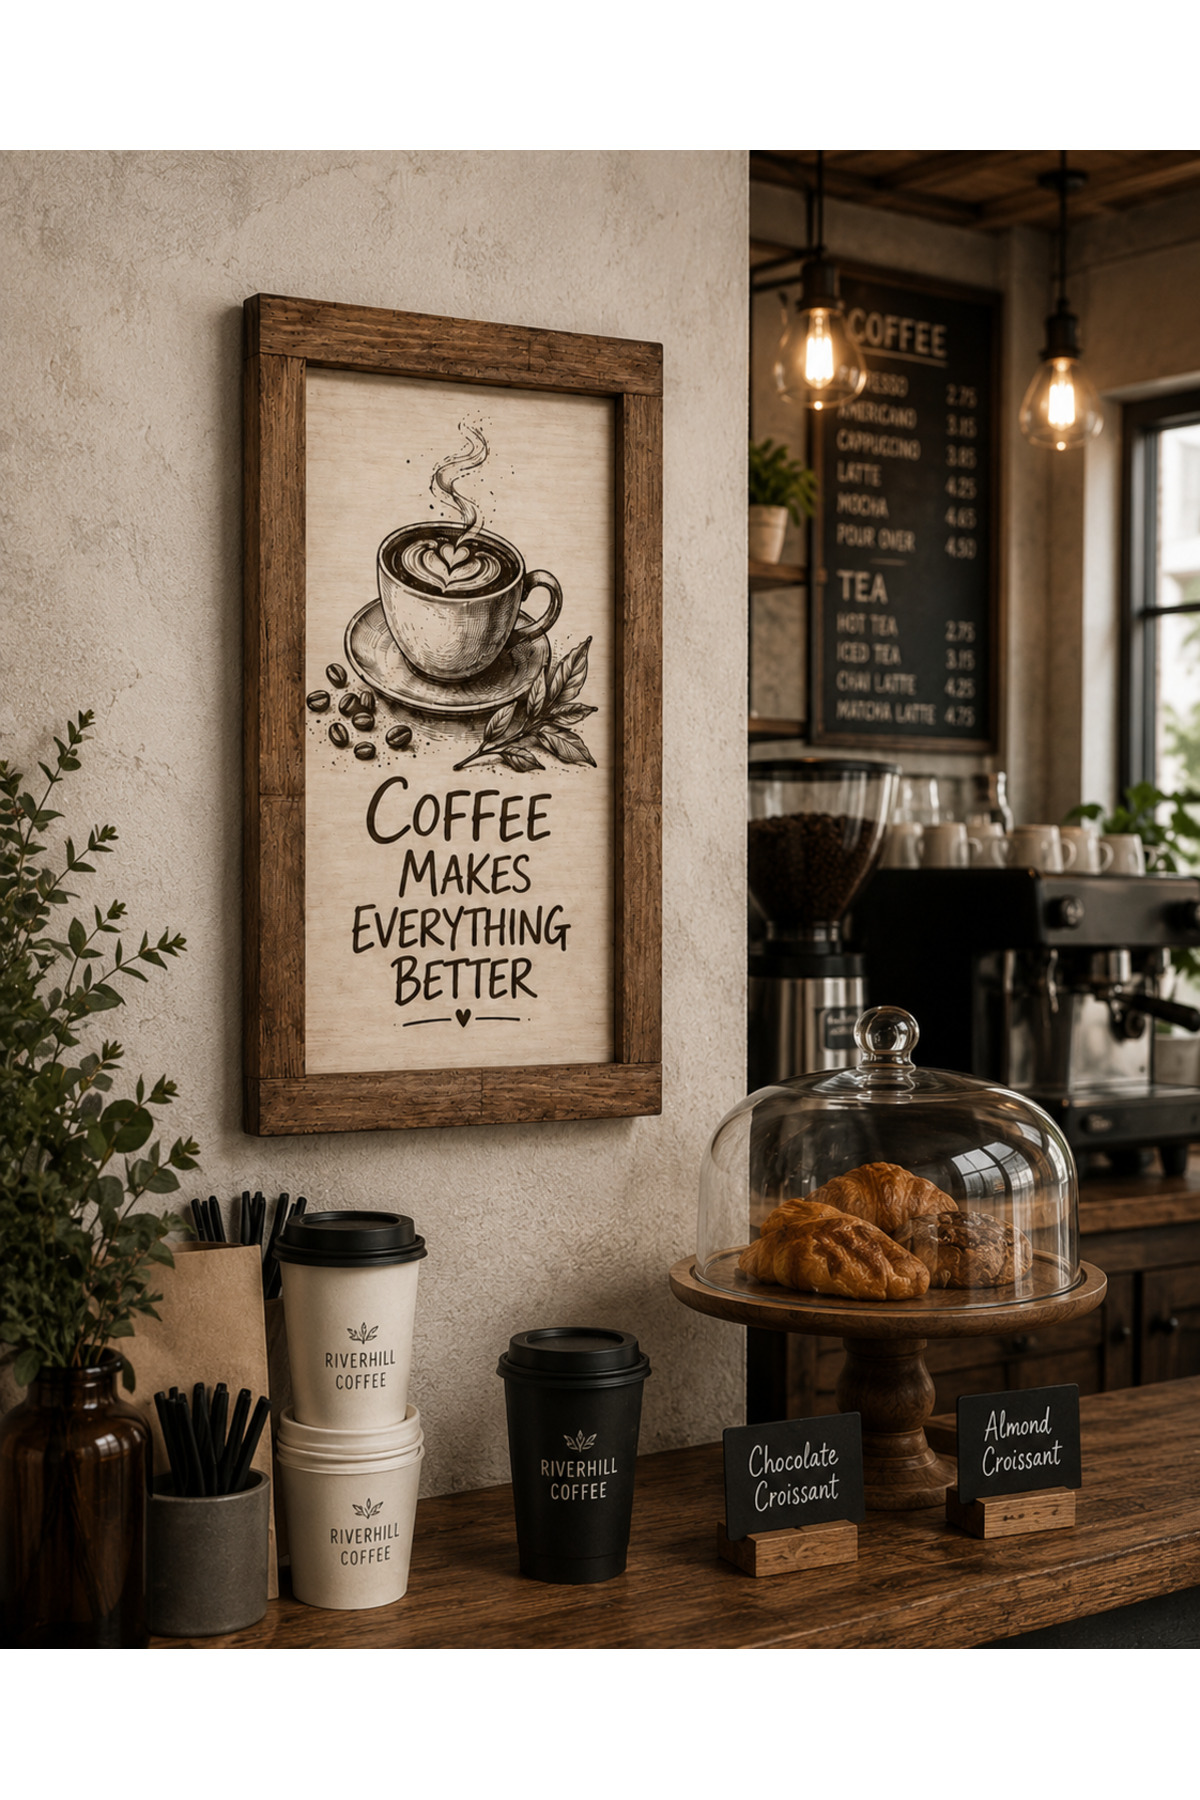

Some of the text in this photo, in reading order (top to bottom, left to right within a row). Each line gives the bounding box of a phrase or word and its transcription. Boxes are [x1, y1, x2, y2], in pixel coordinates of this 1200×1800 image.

[847, 307, 947, 358] COFFEE
[837, 400, 917, 430] AMERICANO
[836, 428, 921, 461] CAPPUCCINO
[836, 459, 977, 500] LATTE 4.25
[836, 491, 889, 519] MOCHA
[836, 522, 875, 549] POUR
[878, 527, 916, 554] OVER
[836, 569, 888, 604] TEA
[836, 611, 976, 643] HOT TEA 2.75
[836, 640, 870, 664] ICED
[873, 642, 902, 666] TEA
[836, 669, 976, 699] CHAI LATTE 4.25
[836, 699, 976, 728] MATCHA LATTE 4.75
[366, 775, 552, 844] COFFEE
[399, 849, 531, 898] MAKES
[352, 904, 571, 954] EVERYTHING
[391, 955, 538, 1006] BETTER
[325, 1349, 396, 1369] RIVERHILL
[335, 1373, 386, 1390] COFFEE
[984, 1405, 1052, 1443] Almond
[541, 1457, 618, 1478] RIVERHILL
[748, 1441, 839, 1478] Chocolate
[982, 1440, 1063, 1477] Croissant
[551, 1481, 607, 1501] COFFEE
[754, 1473, 840, 1513] Croissant
[330, 1522, 400, 1544] RIVERHILL
[340, 1545, 391, 1566] COFFEE
